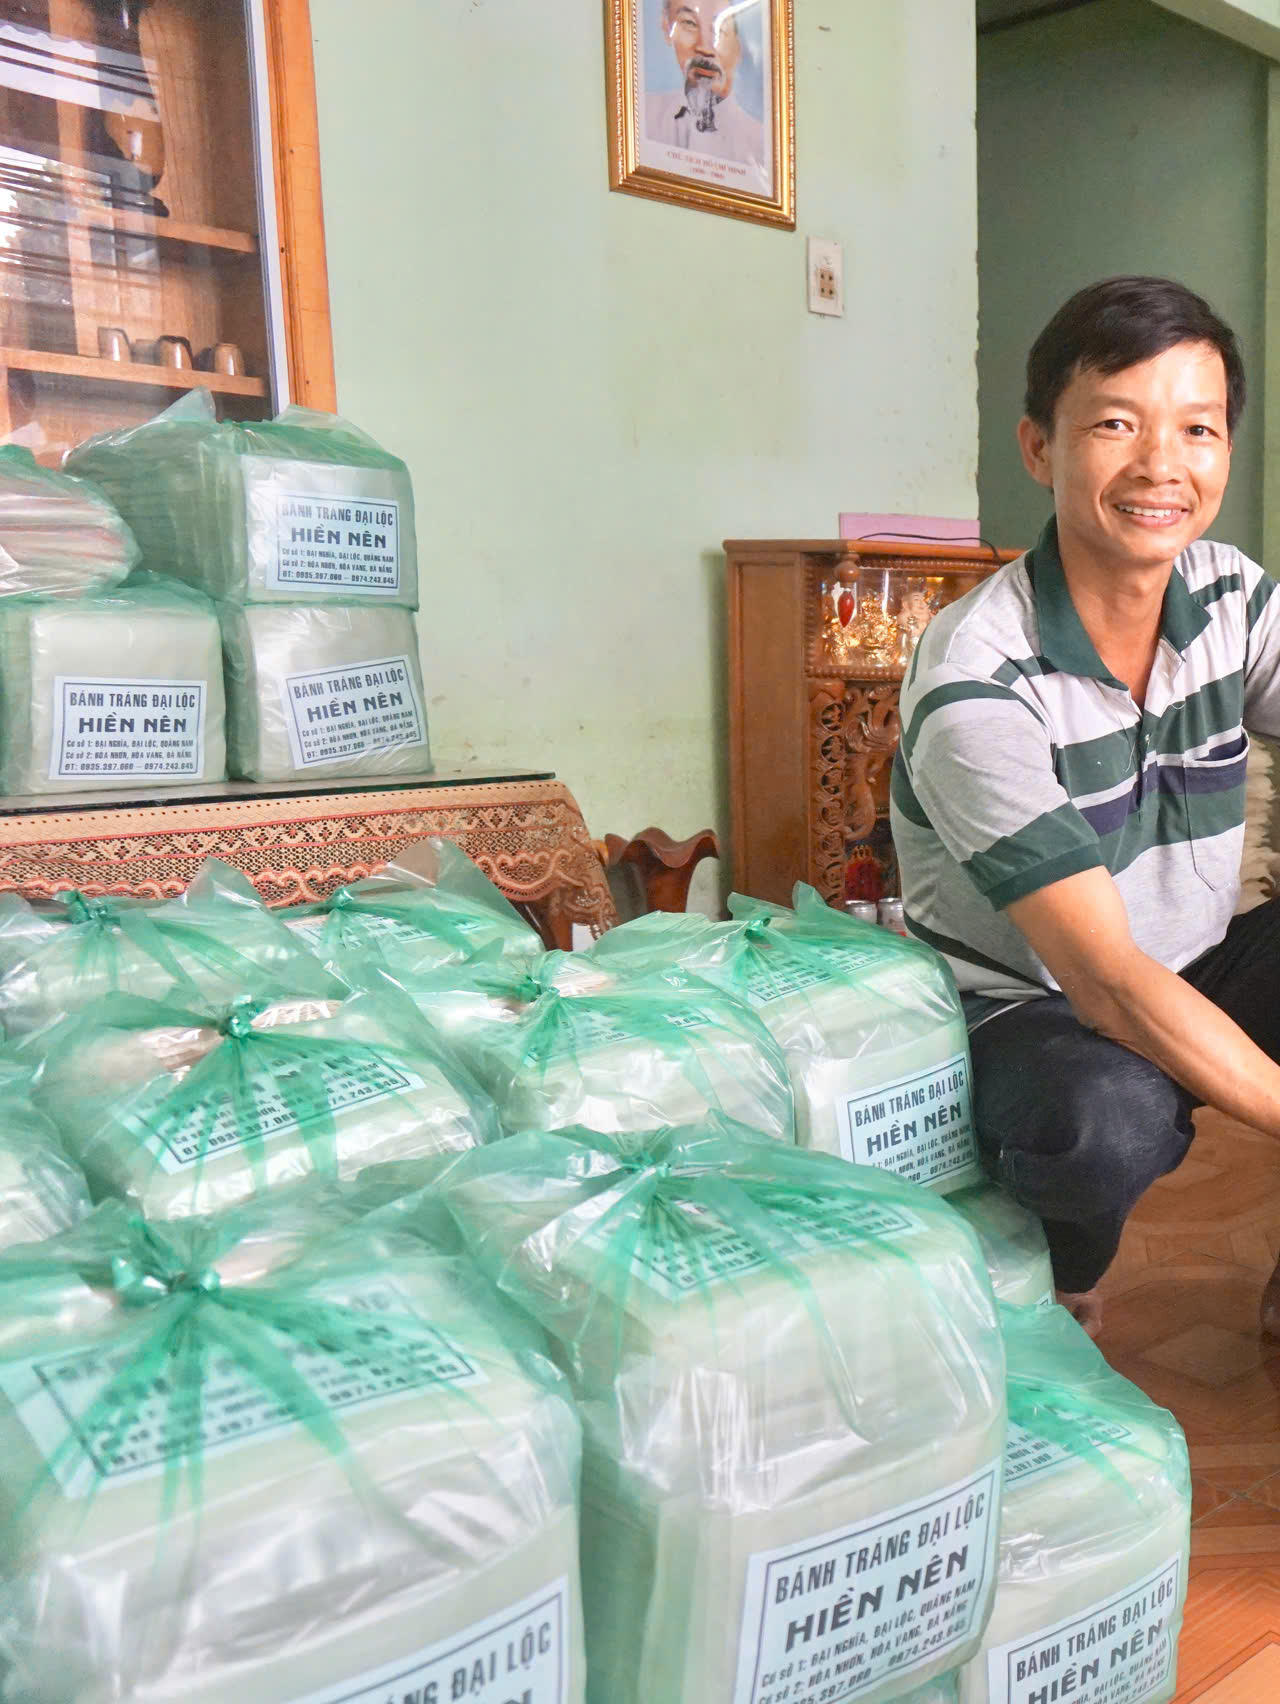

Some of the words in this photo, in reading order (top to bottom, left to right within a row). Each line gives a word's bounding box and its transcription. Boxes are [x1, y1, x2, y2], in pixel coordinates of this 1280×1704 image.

[282, 503, 312, 519] BÁNH
[316, 506, 352, 522] TRÁNG
[356, 510, 372, 525] ĐẠI
[376, 510, 393, 527] LỘC
[292, 524, 340, 544] HIỀN
[348, 531, 386, 548] NÊN
[70, 691, 104, 706] BÁNH
[109, 692, 147, 707] TRÁNG
[152, 694, 172, 710] ĐẠI
[176, 692, 195, 710] LỘC
[293, 681, 324, 699] BÁNH
[327, 675, 362, 693] TRÁNG
[365, 672, 384, 688] ĐẠI
[385, 667, 404, 684] LỘC
[307, 698, 357, 723] HIỀN
[363, 692, 403, 712] NÊN
[79, 713, 134, 733] HIỀN
[144, 716, 187, 732] NÊN
[855, 1102, 886, 1127] BÁNH
[889, 1088, 925, 1114] TRÁNG
[928, 1079, 946, 1101] ĐẠI
[948, 1070, 964, 1092] LỘC
[867, 1120, 917, 1157] HIỀN
[924, 1102, 962, 1133] NÊN
[775, 1561, 836, 1604] BÁNH
[845, 1530, 911, 1578] TRÁNG
[917, 1512, 950, 1548] ĐẠI
[954, 1493, 985, 1530] LỘC
[785, 1585, 884, 1653] HIỀN
[896, 1545, 969, 1602] NÊN
[1016, 1643, 1061, 1682] BÁNH
[1066, 1615, 1117, 1657] TRÁNG
[1122, 1597, 1147, 1627] ĐẠI
[1151, 1577, 1173, 1609] LỘC
[451, 1651, 496, 1701] ĐẠI
[507, 1621, 551, 1672] LỘC
[1028, 1658, 1100, 1704] HIỀN
[1109, 1618, 1163, 1669] NÊN
